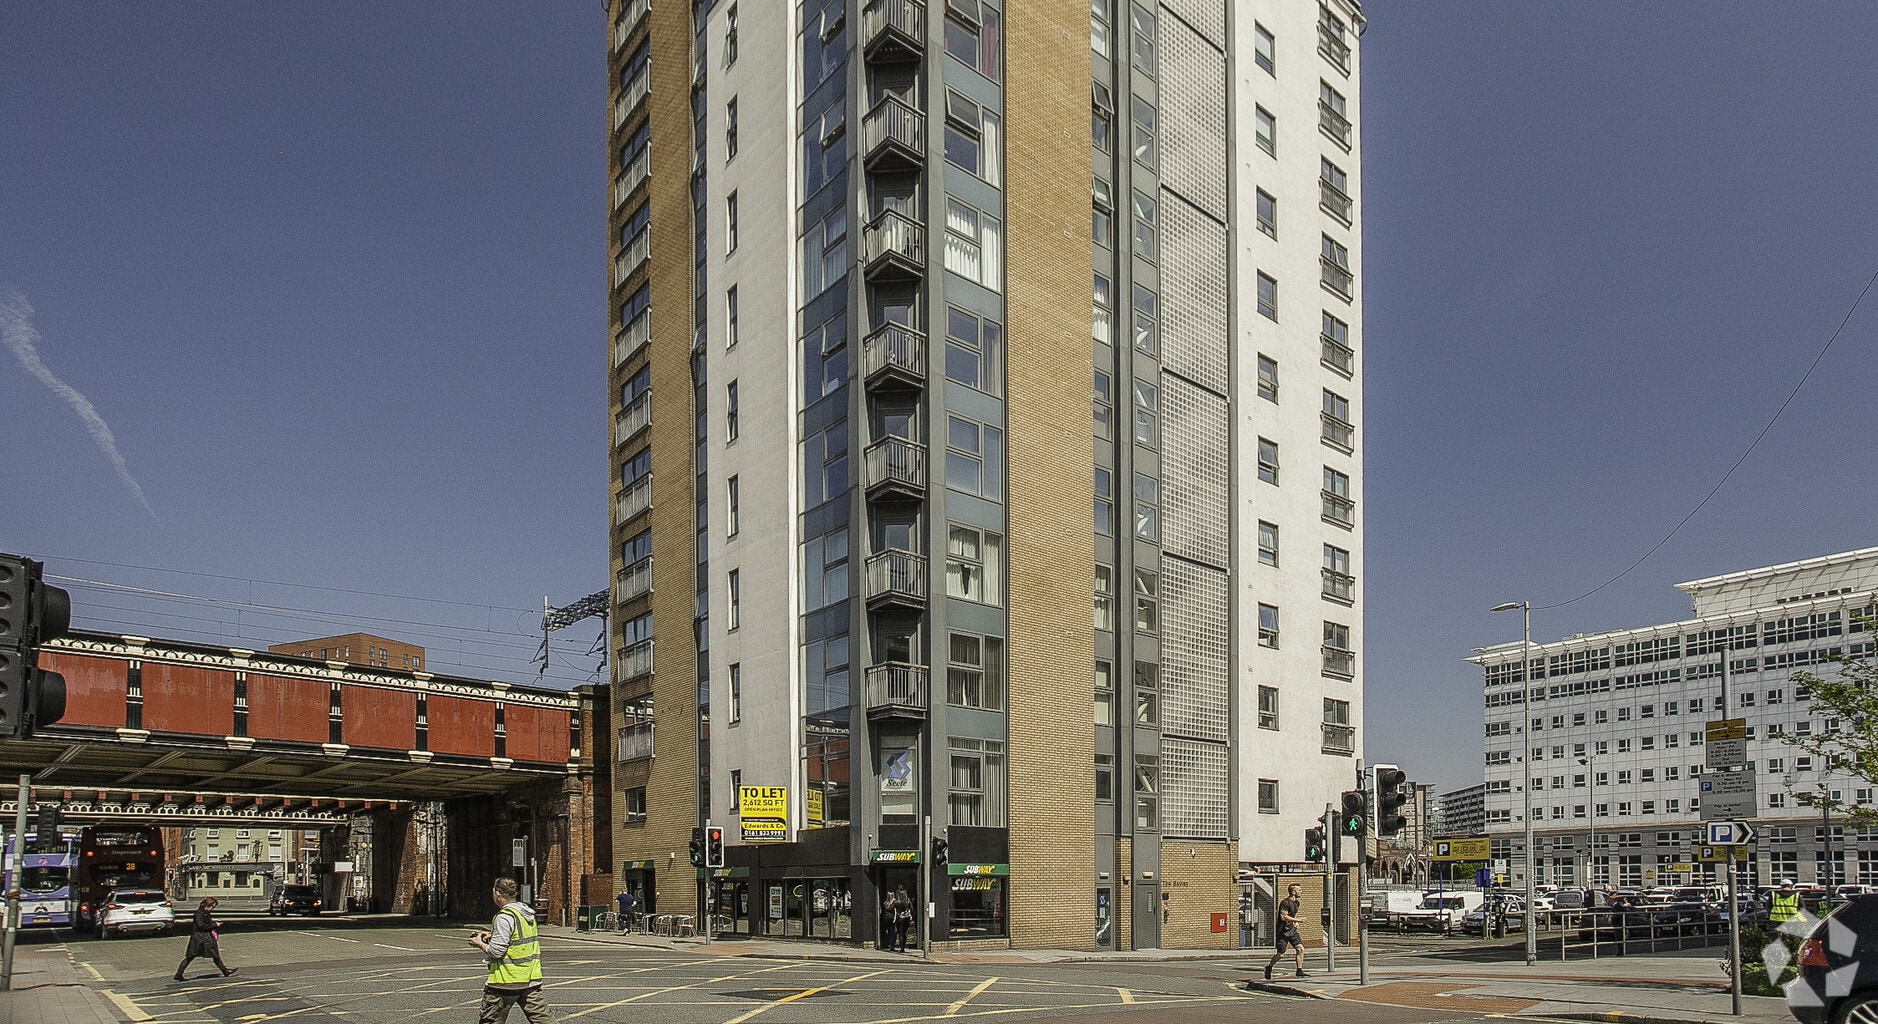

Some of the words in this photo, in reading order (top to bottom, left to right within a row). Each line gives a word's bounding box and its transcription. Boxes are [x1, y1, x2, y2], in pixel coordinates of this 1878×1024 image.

[742, 788, 758, 798] TO
[762, 788, 786, 798] LET
[1716, 826, 1730, 842] P
[1439, 844, 1448, 855] P
[1704, 849, 1711, 857] P
[876, 852, 916, 861] SUBWAY
[964, 865, 996, 874] SUBWAY
[952, 878, 997, 891] SUBWAY
